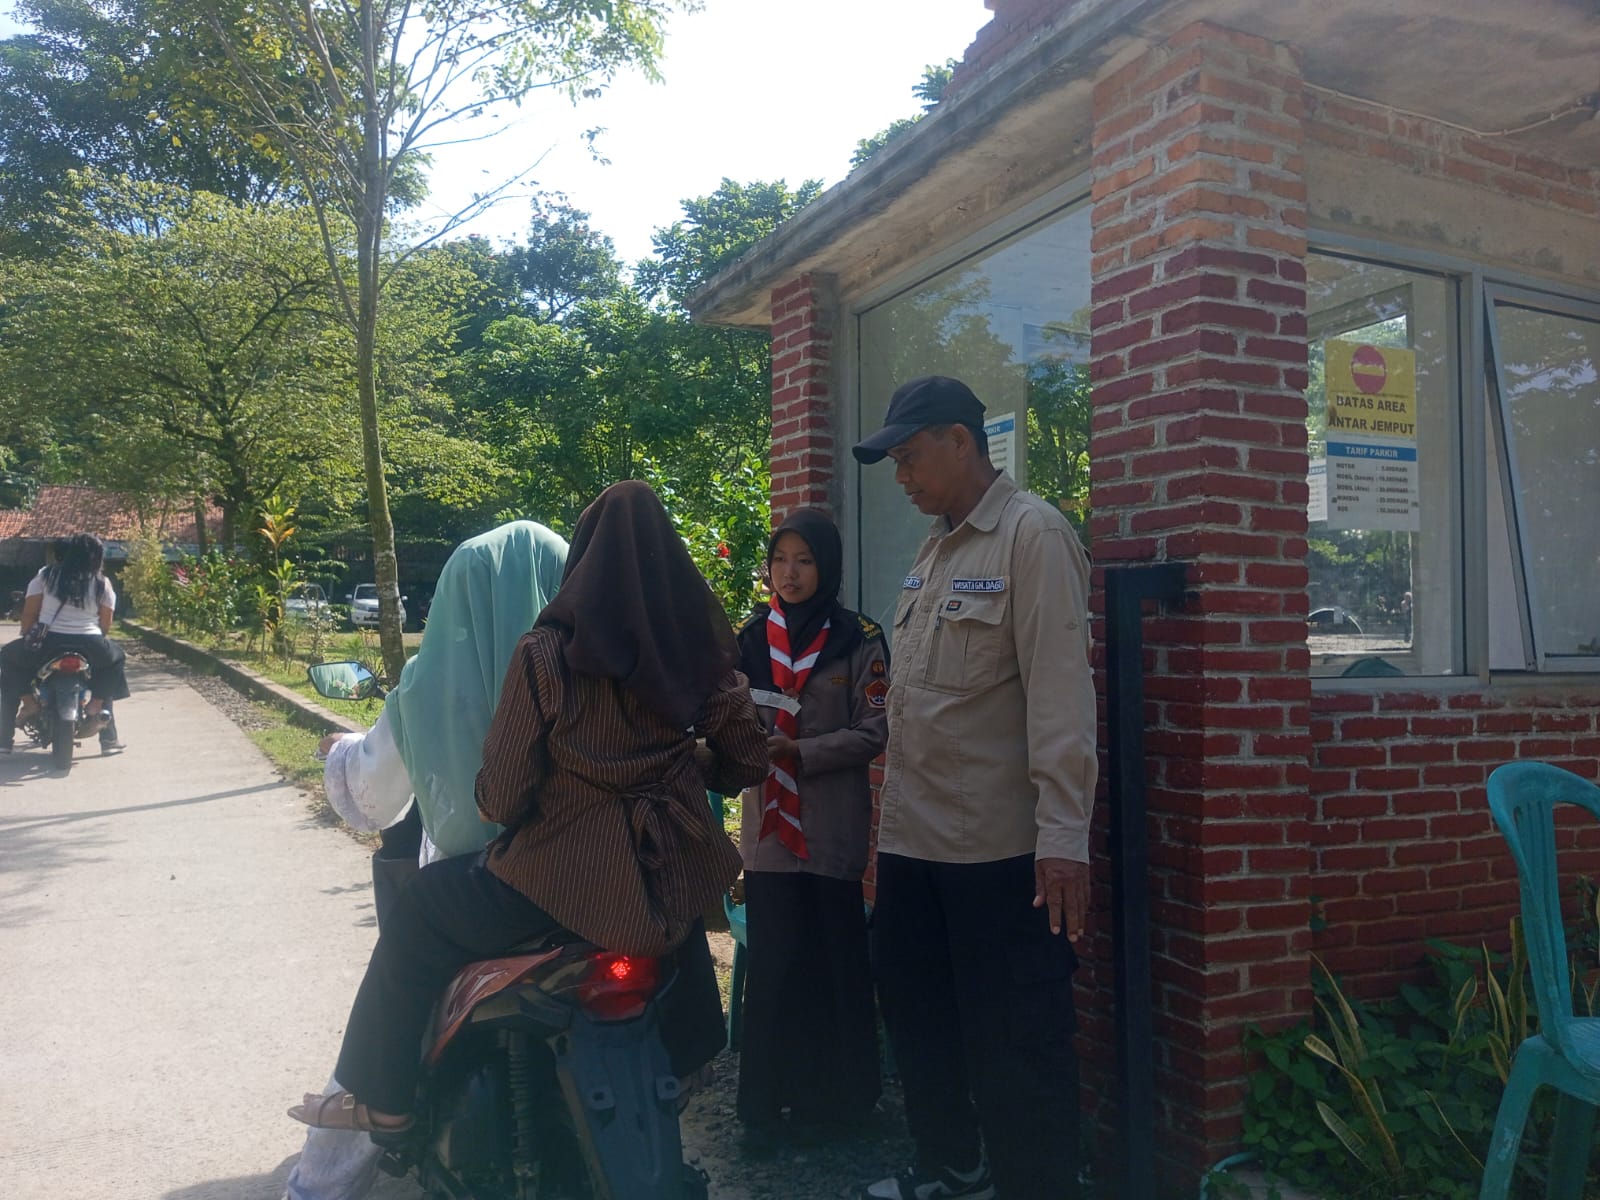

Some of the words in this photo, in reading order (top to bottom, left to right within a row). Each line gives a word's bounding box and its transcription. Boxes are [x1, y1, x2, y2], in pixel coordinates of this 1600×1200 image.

[1336, 395, 1374, 409] BATAS
[1377, 400, 1407, 413] AREA
[1328, 415, 1367, 430] ANTAR
[1370, 420, 1414, 434] JEMPUT
[1345, 446, 1368, 456] TARIF
[1369, 448, 1398, 458] PARKIR
